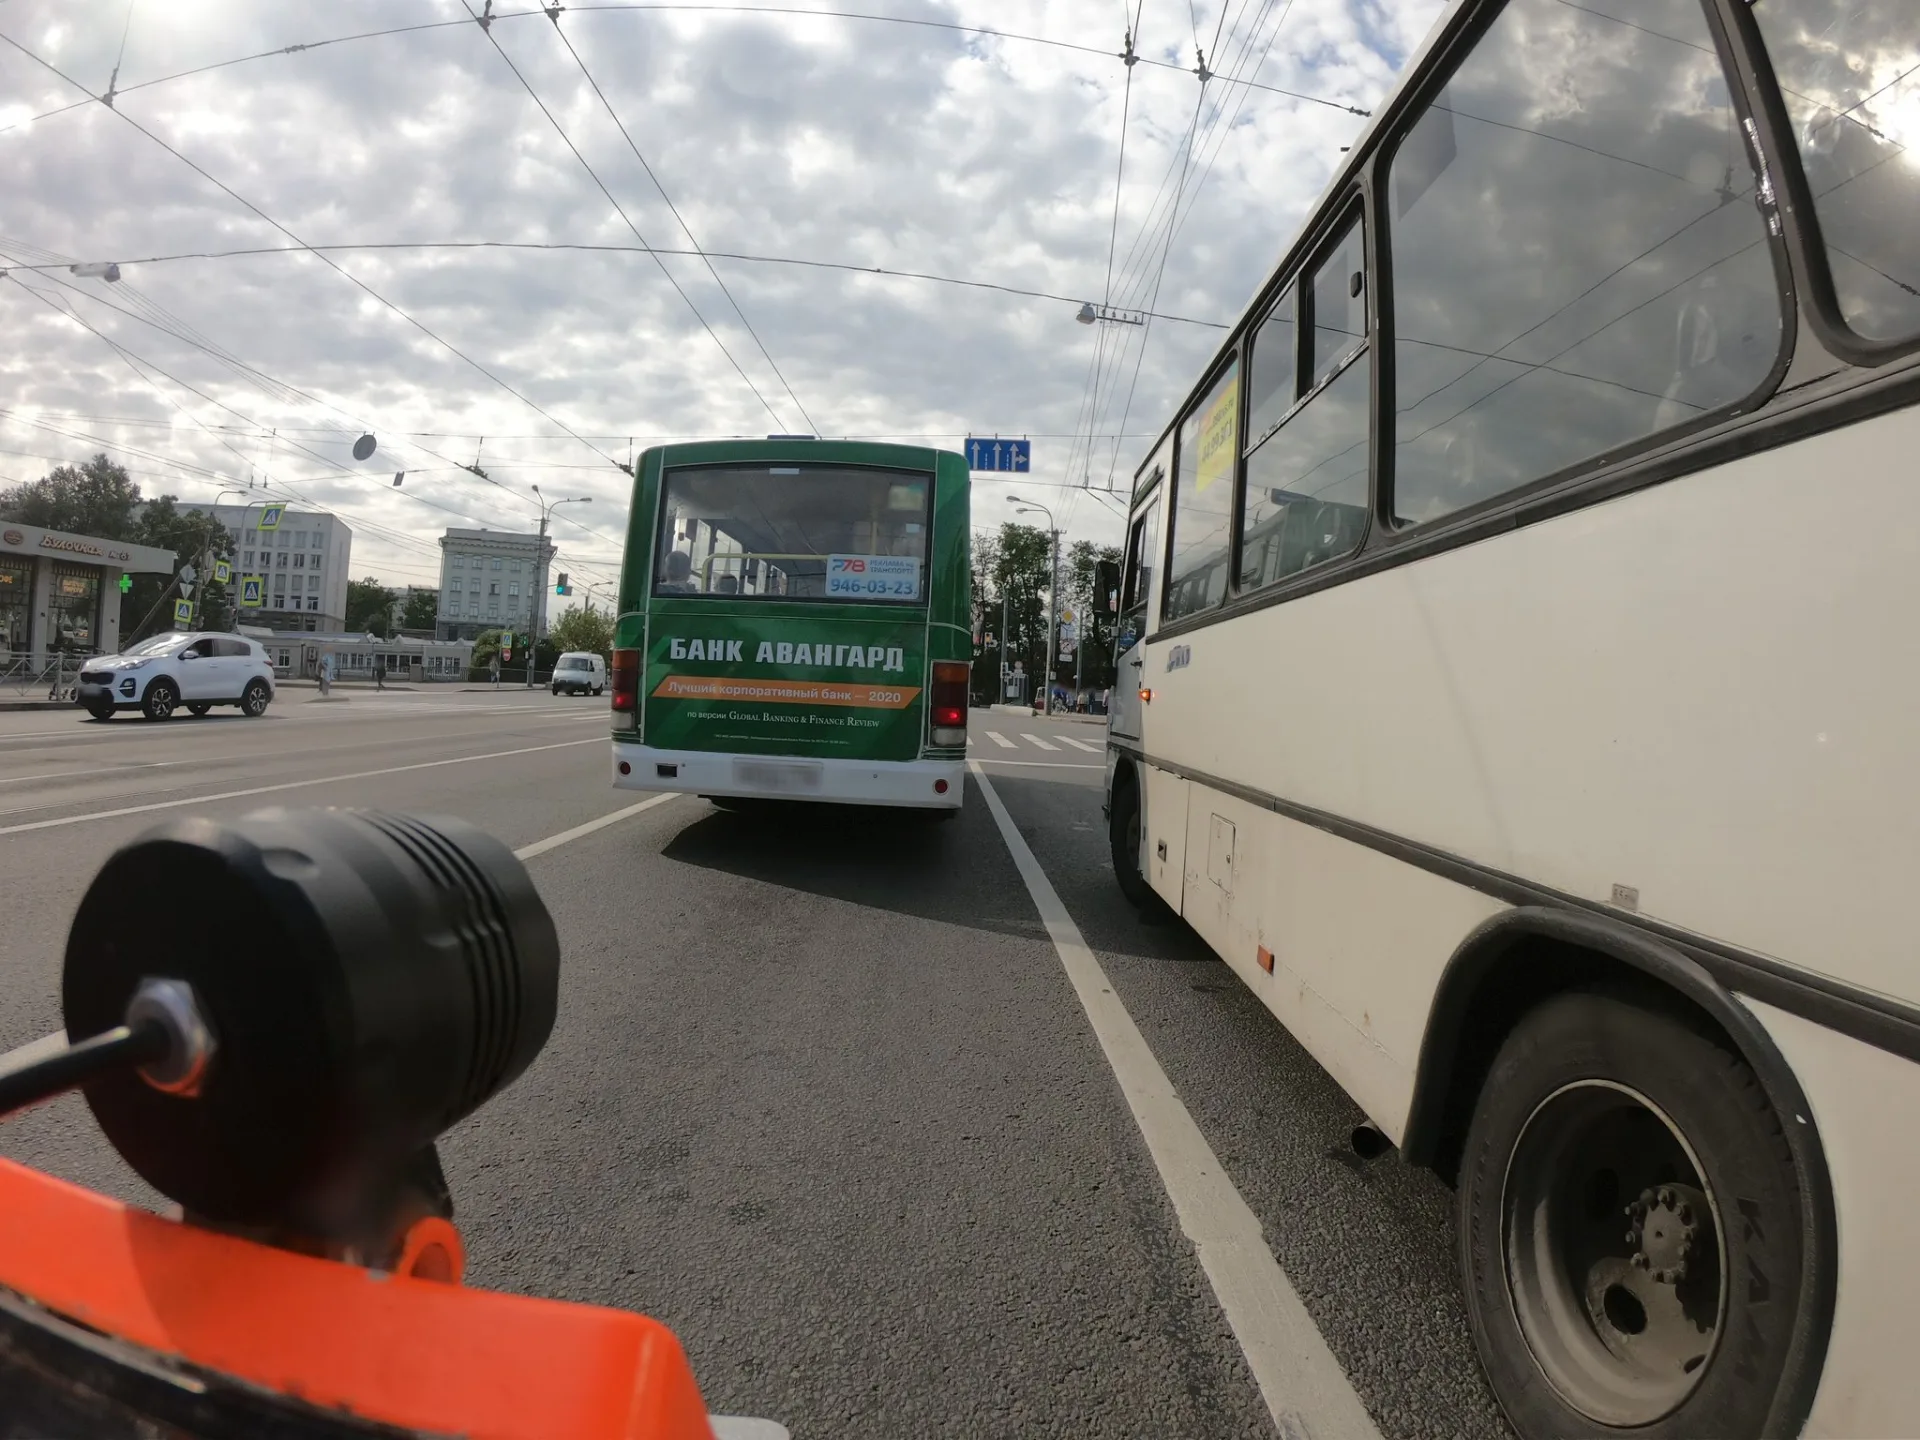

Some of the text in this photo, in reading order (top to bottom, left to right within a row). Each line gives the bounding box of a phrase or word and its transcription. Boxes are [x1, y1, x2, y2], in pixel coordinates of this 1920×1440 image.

[830, 579, 913, 595] 946-03-23
[670, 638, 904, 672] БАНК АВАНГАРД
[668, 681, 717, 694] Лучший
[719, 685, 818, 698] корпоративный
[821, 688, 852, 701] банк
[868, 691, 901, 703] 2020
[698, 711, 727, 720] версии
